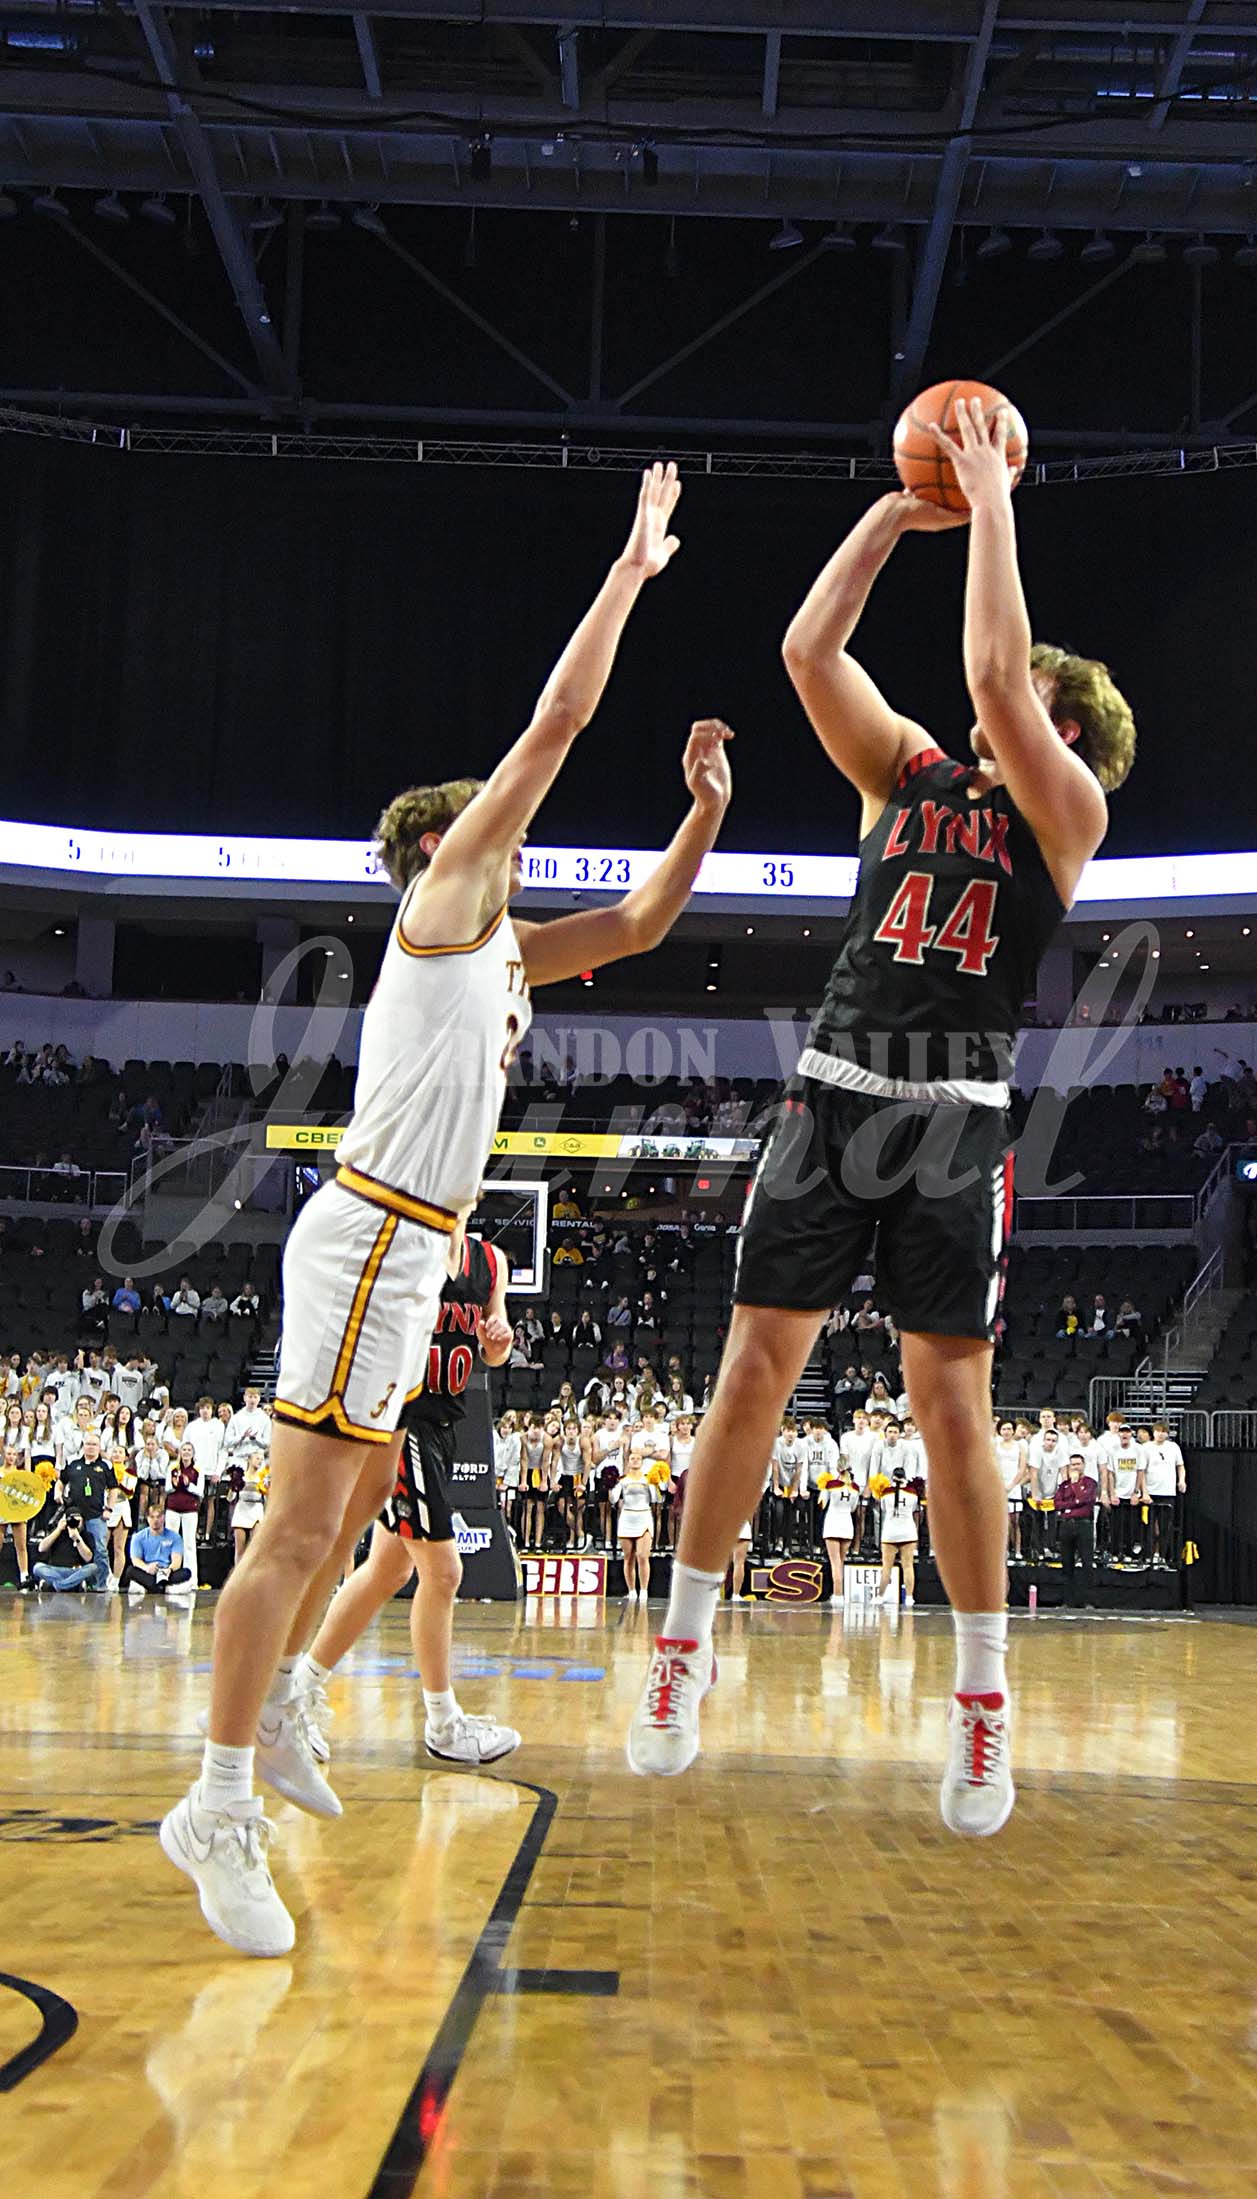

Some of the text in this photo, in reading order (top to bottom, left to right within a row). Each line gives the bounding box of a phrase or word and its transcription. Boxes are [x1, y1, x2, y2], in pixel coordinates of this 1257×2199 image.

[882, 800, 1012, 876] LYNX
[575, 857, 631, 883] 3:23
[763, 862, 794, 887] 35
[873, 871, 1000, 977] 44
[427, 1345, 473, 1396] 10
[452, 1462, 489, 1474] FORD
